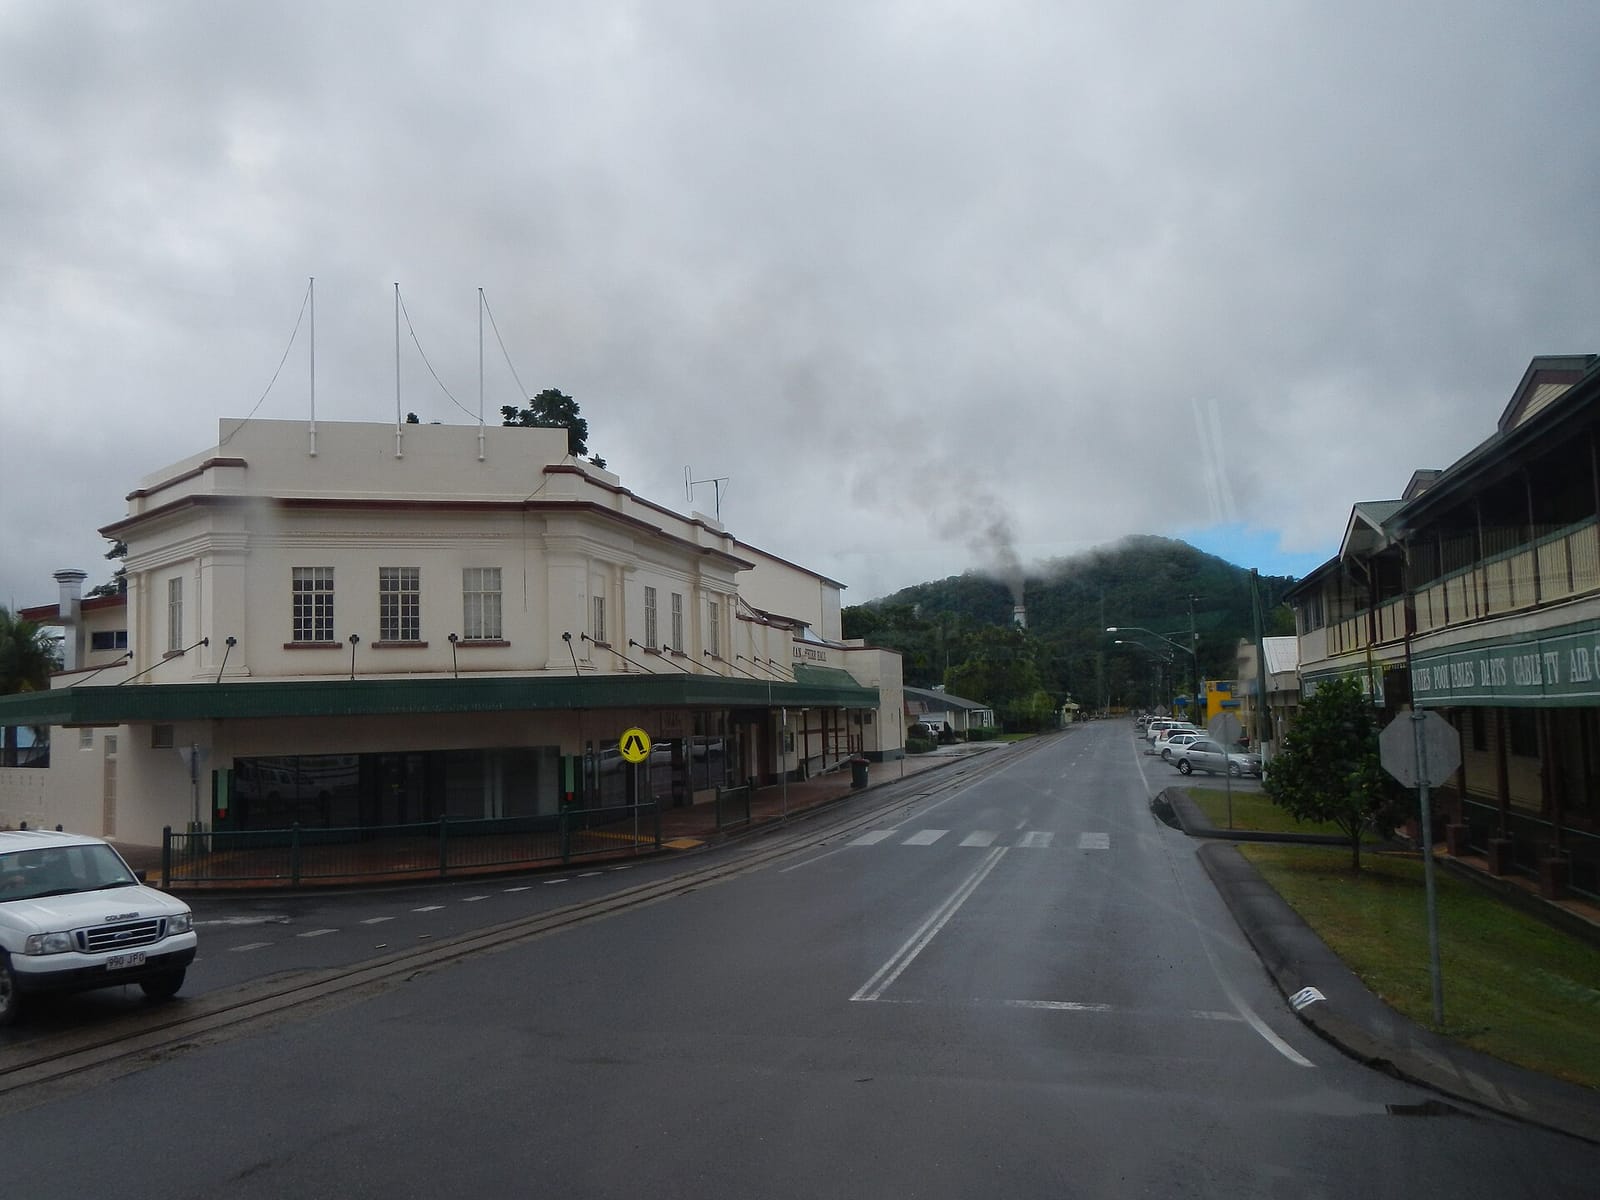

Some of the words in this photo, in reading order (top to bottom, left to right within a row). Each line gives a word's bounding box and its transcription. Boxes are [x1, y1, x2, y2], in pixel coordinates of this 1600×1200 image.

[1450, 661, 1475, 688] TABLES
[1480, 657, 1506, 686] DARTS
[1513, 653, 1543, 686] CABLE
[1543, 651, 1559, 685] TV
[1569, 647, 1592, 683] AIR
